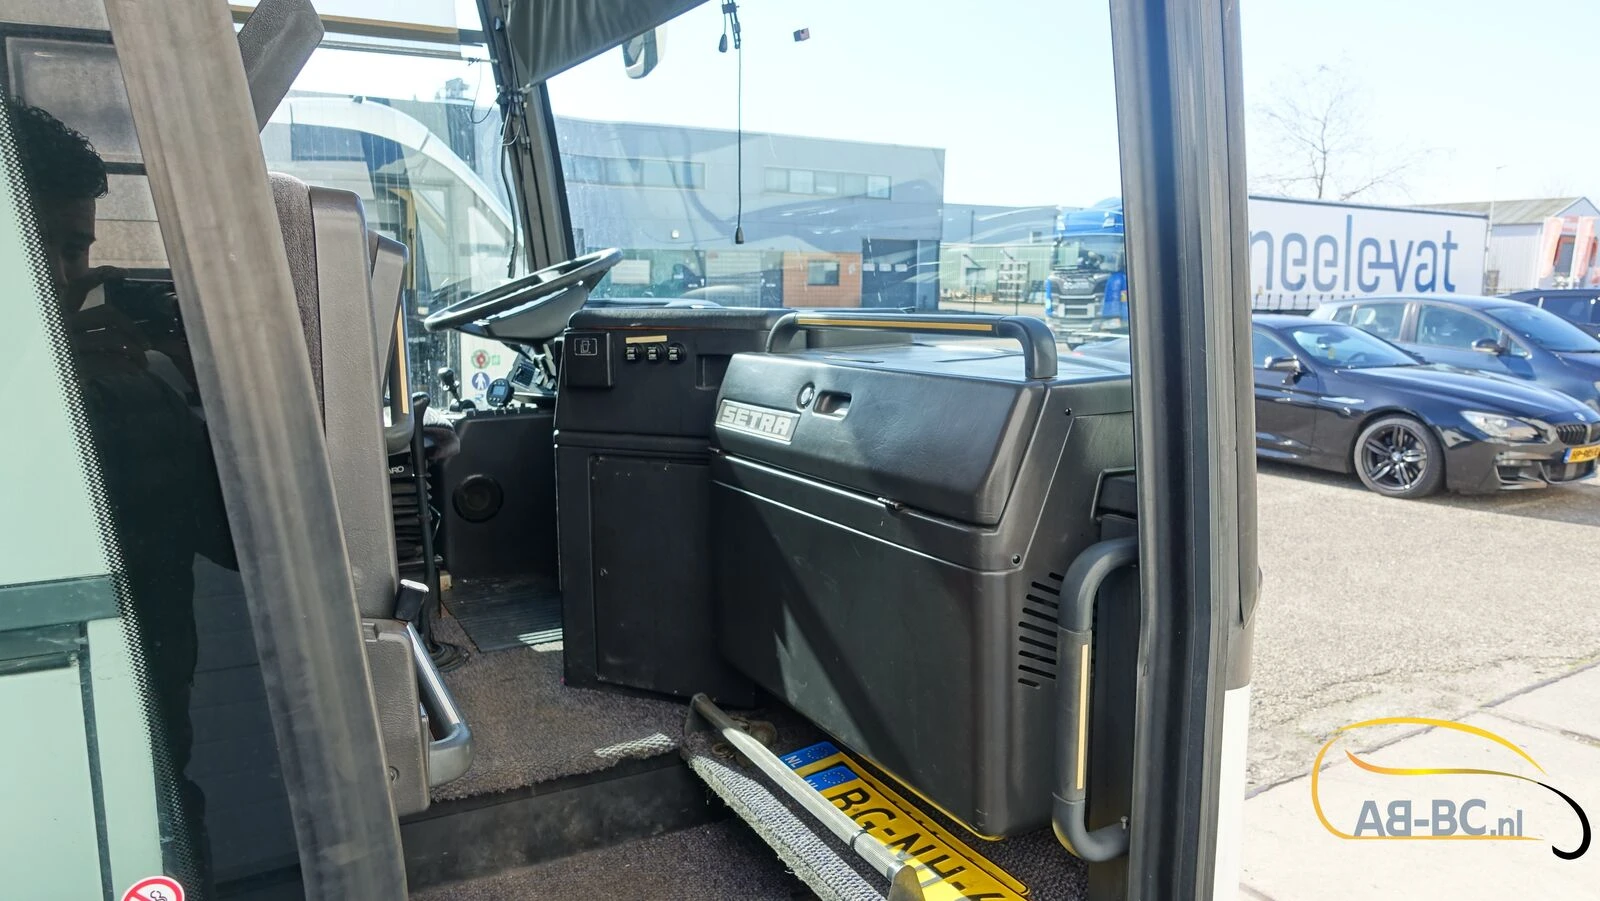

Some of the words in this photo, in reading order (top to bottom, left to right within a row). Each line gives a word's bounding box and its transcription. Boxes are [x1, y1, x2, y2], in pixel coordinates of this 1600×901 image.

[721, 404, 792, 436] SETRA
[784, 755, 803, 768] NL
[828, 787, 1006, 901] BG-NH-
